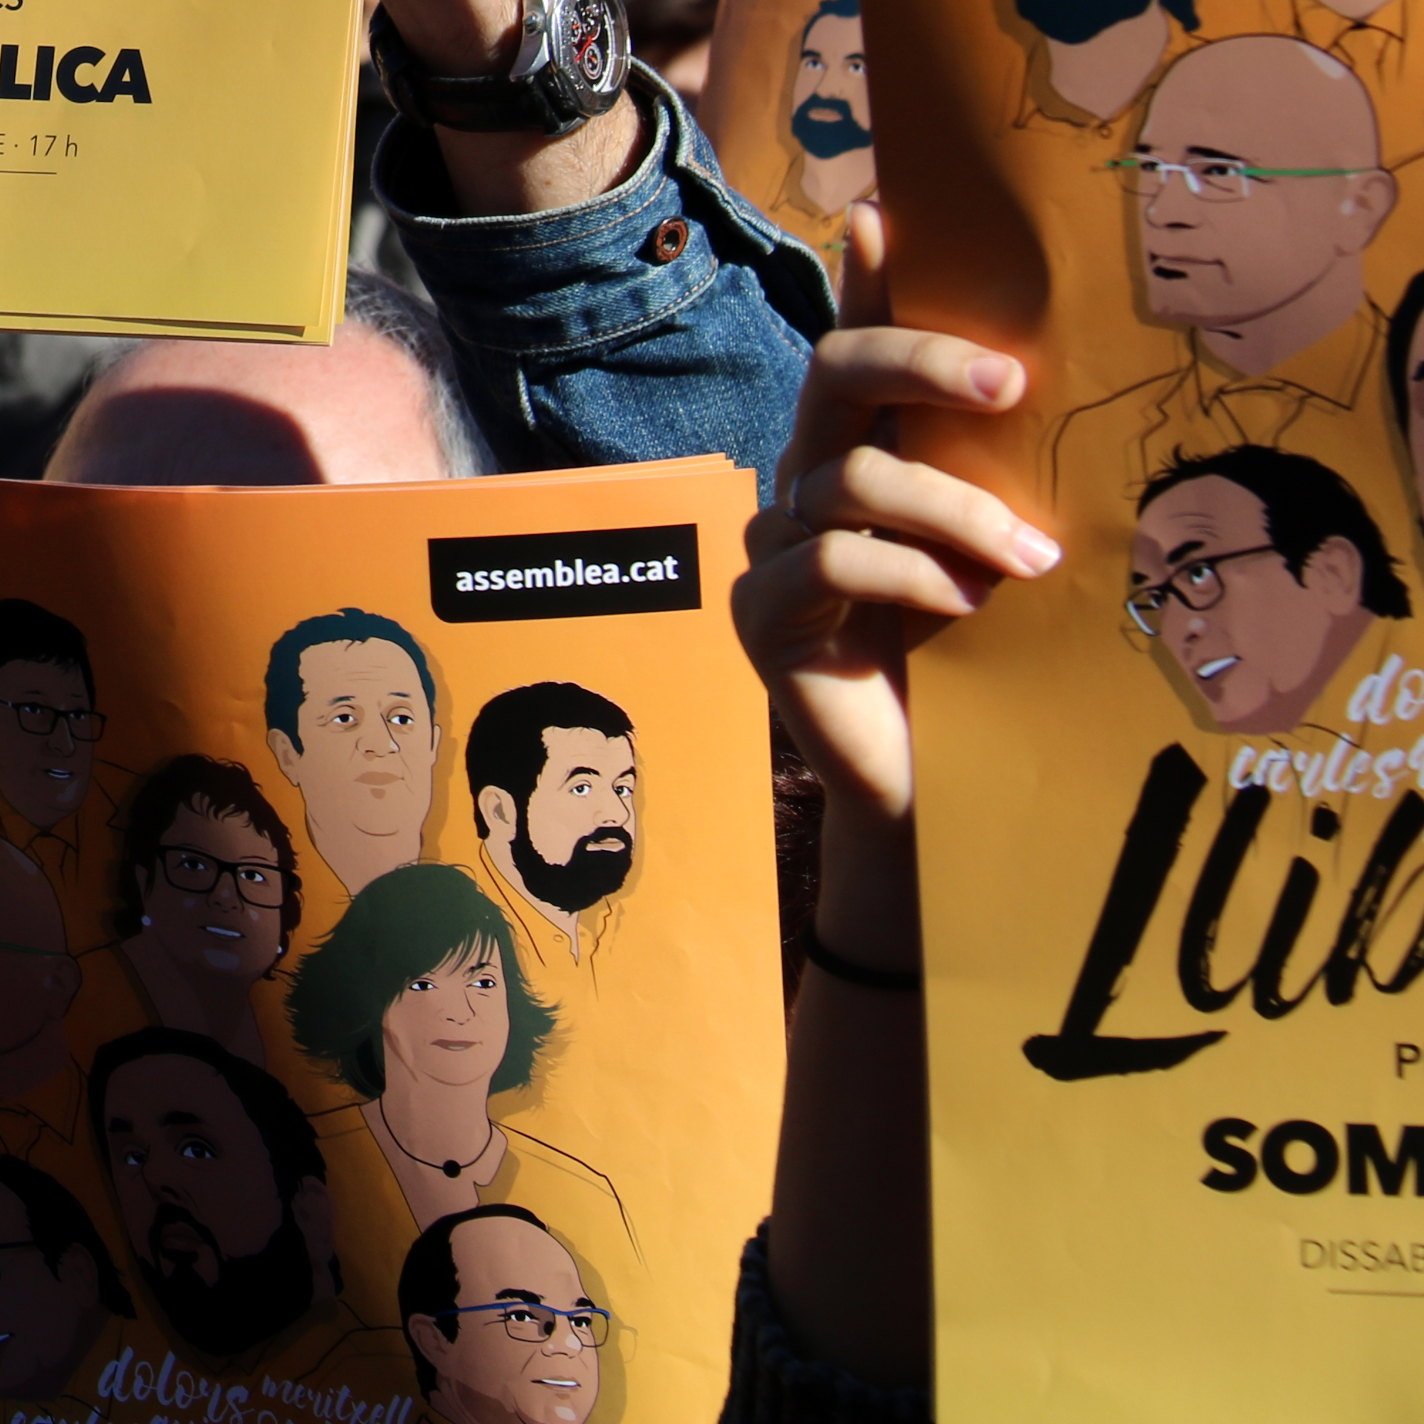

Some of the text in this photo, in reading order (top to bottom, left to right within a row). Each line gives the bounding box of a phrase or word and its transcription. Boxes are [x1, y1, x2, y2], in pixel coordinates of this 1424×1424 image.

[29, 133, 57, 158] 17
[65, 134, 79, 159] h
[456, 555, 679, 592] assemblea.cat
[1228, 733, 1408, 799] carles
[1200, 1117, 1424, 1195] SOM
